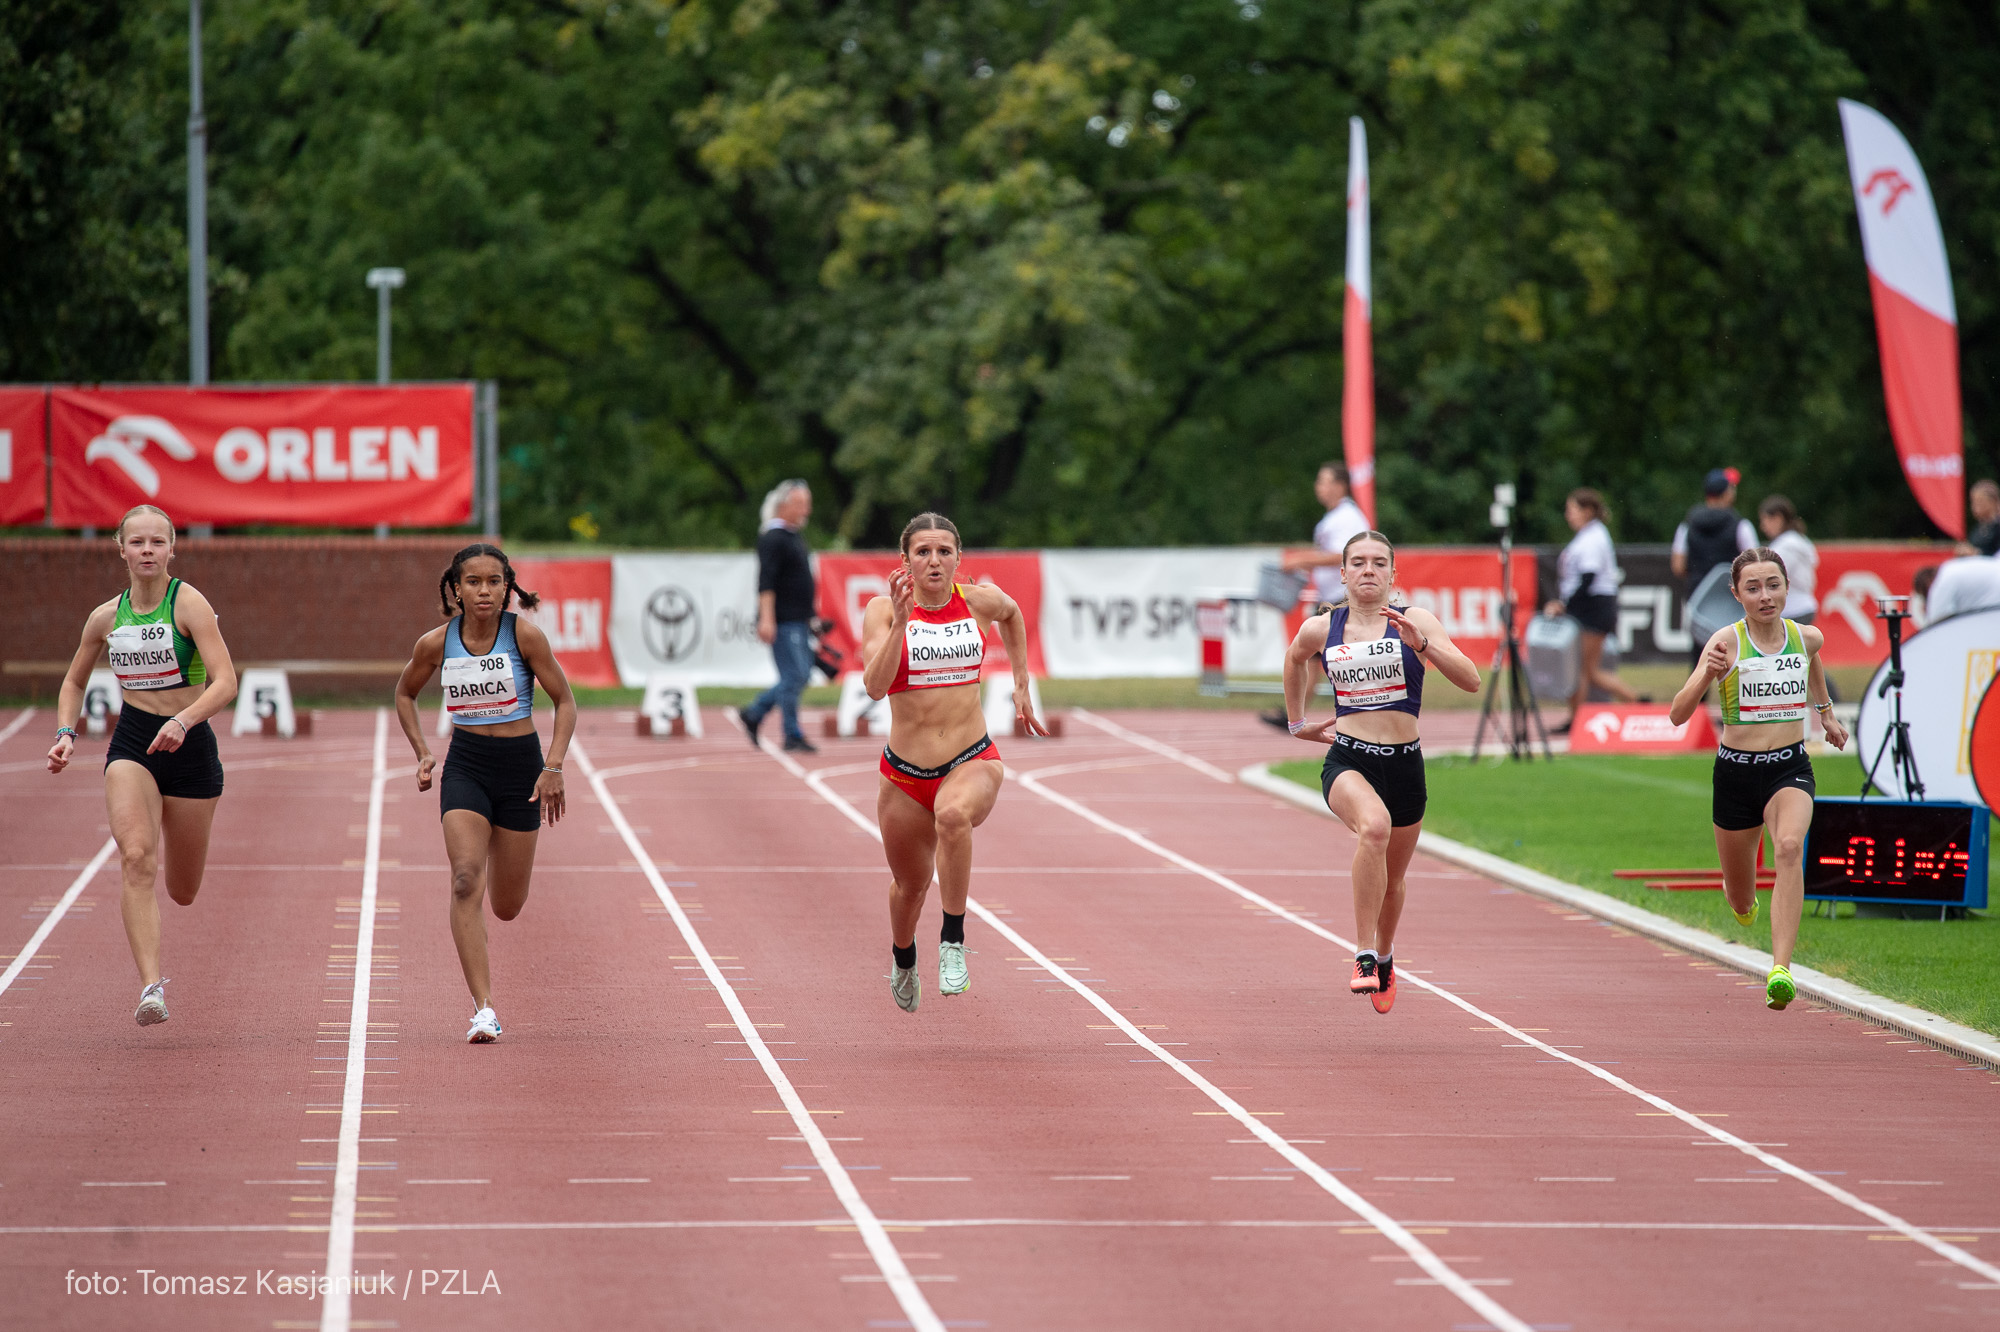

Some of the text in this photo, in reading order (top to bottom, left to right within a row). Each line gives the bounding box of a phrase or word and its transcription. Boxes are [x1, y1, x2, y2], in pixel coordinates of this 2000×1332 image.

[213, 427, 439, 482] ORLEN
[1067, 595, 1258, 639] TVP SPRT
[141, 626, 165, 641] 869
[944, 622, 972, 637] 571
[912, 642, 980, 661] ROMANIUK
[1367, 641, 1394, 656] 158
[110, 650, 174, 666] PRZYBYLSKA
[480, 657, 504, 671] 908
[1775, 657, 1801, 671] 246
[1331, 663, 1402, 683] MARCYNIUK
[449, 680, 507, 698] BARICA
[1742, 680, 1806, 697] NIEZGODA
[85, 687, 111, 719] 6
[253, 686, 278, 718] 5
[661, 689, 684, 720] 3
[1352, 740, 1395, 756] PRO
[1718, 745, 1752, 764] NIKE
[1753, 748, 1793, 764] PRO
